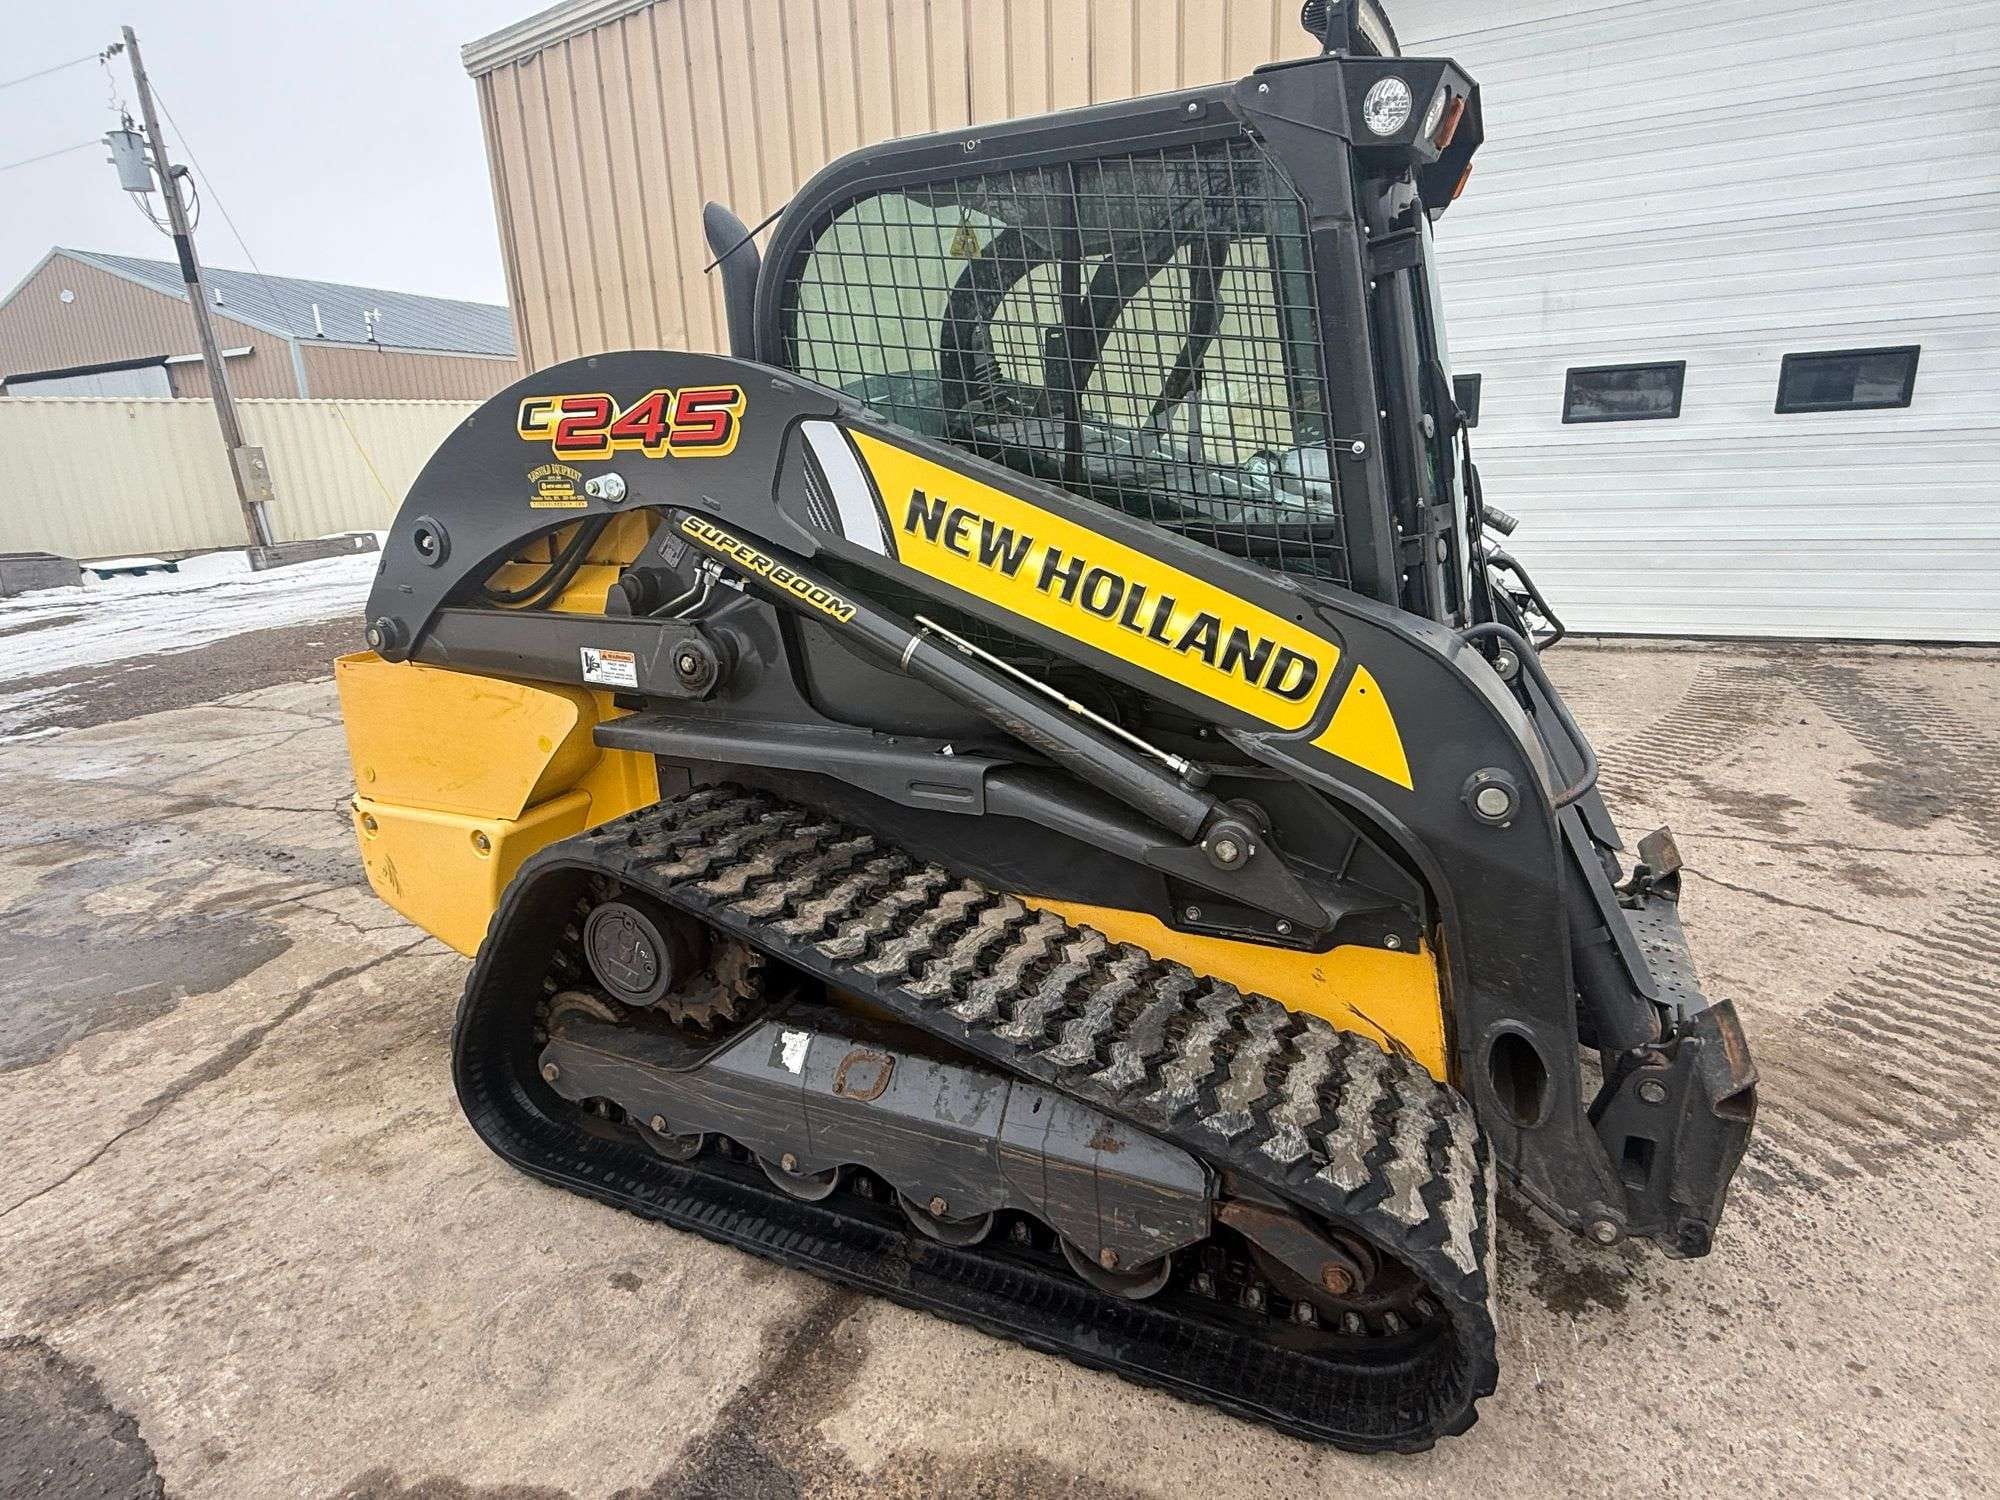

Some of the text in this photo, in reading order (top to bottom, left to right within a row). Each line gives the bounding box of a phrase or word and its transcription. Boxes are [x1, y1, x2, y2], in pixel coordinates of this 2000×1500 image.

[519, 387, 743, 457] C245
[903, 488, 1320, 702] NEW HOLLAND
